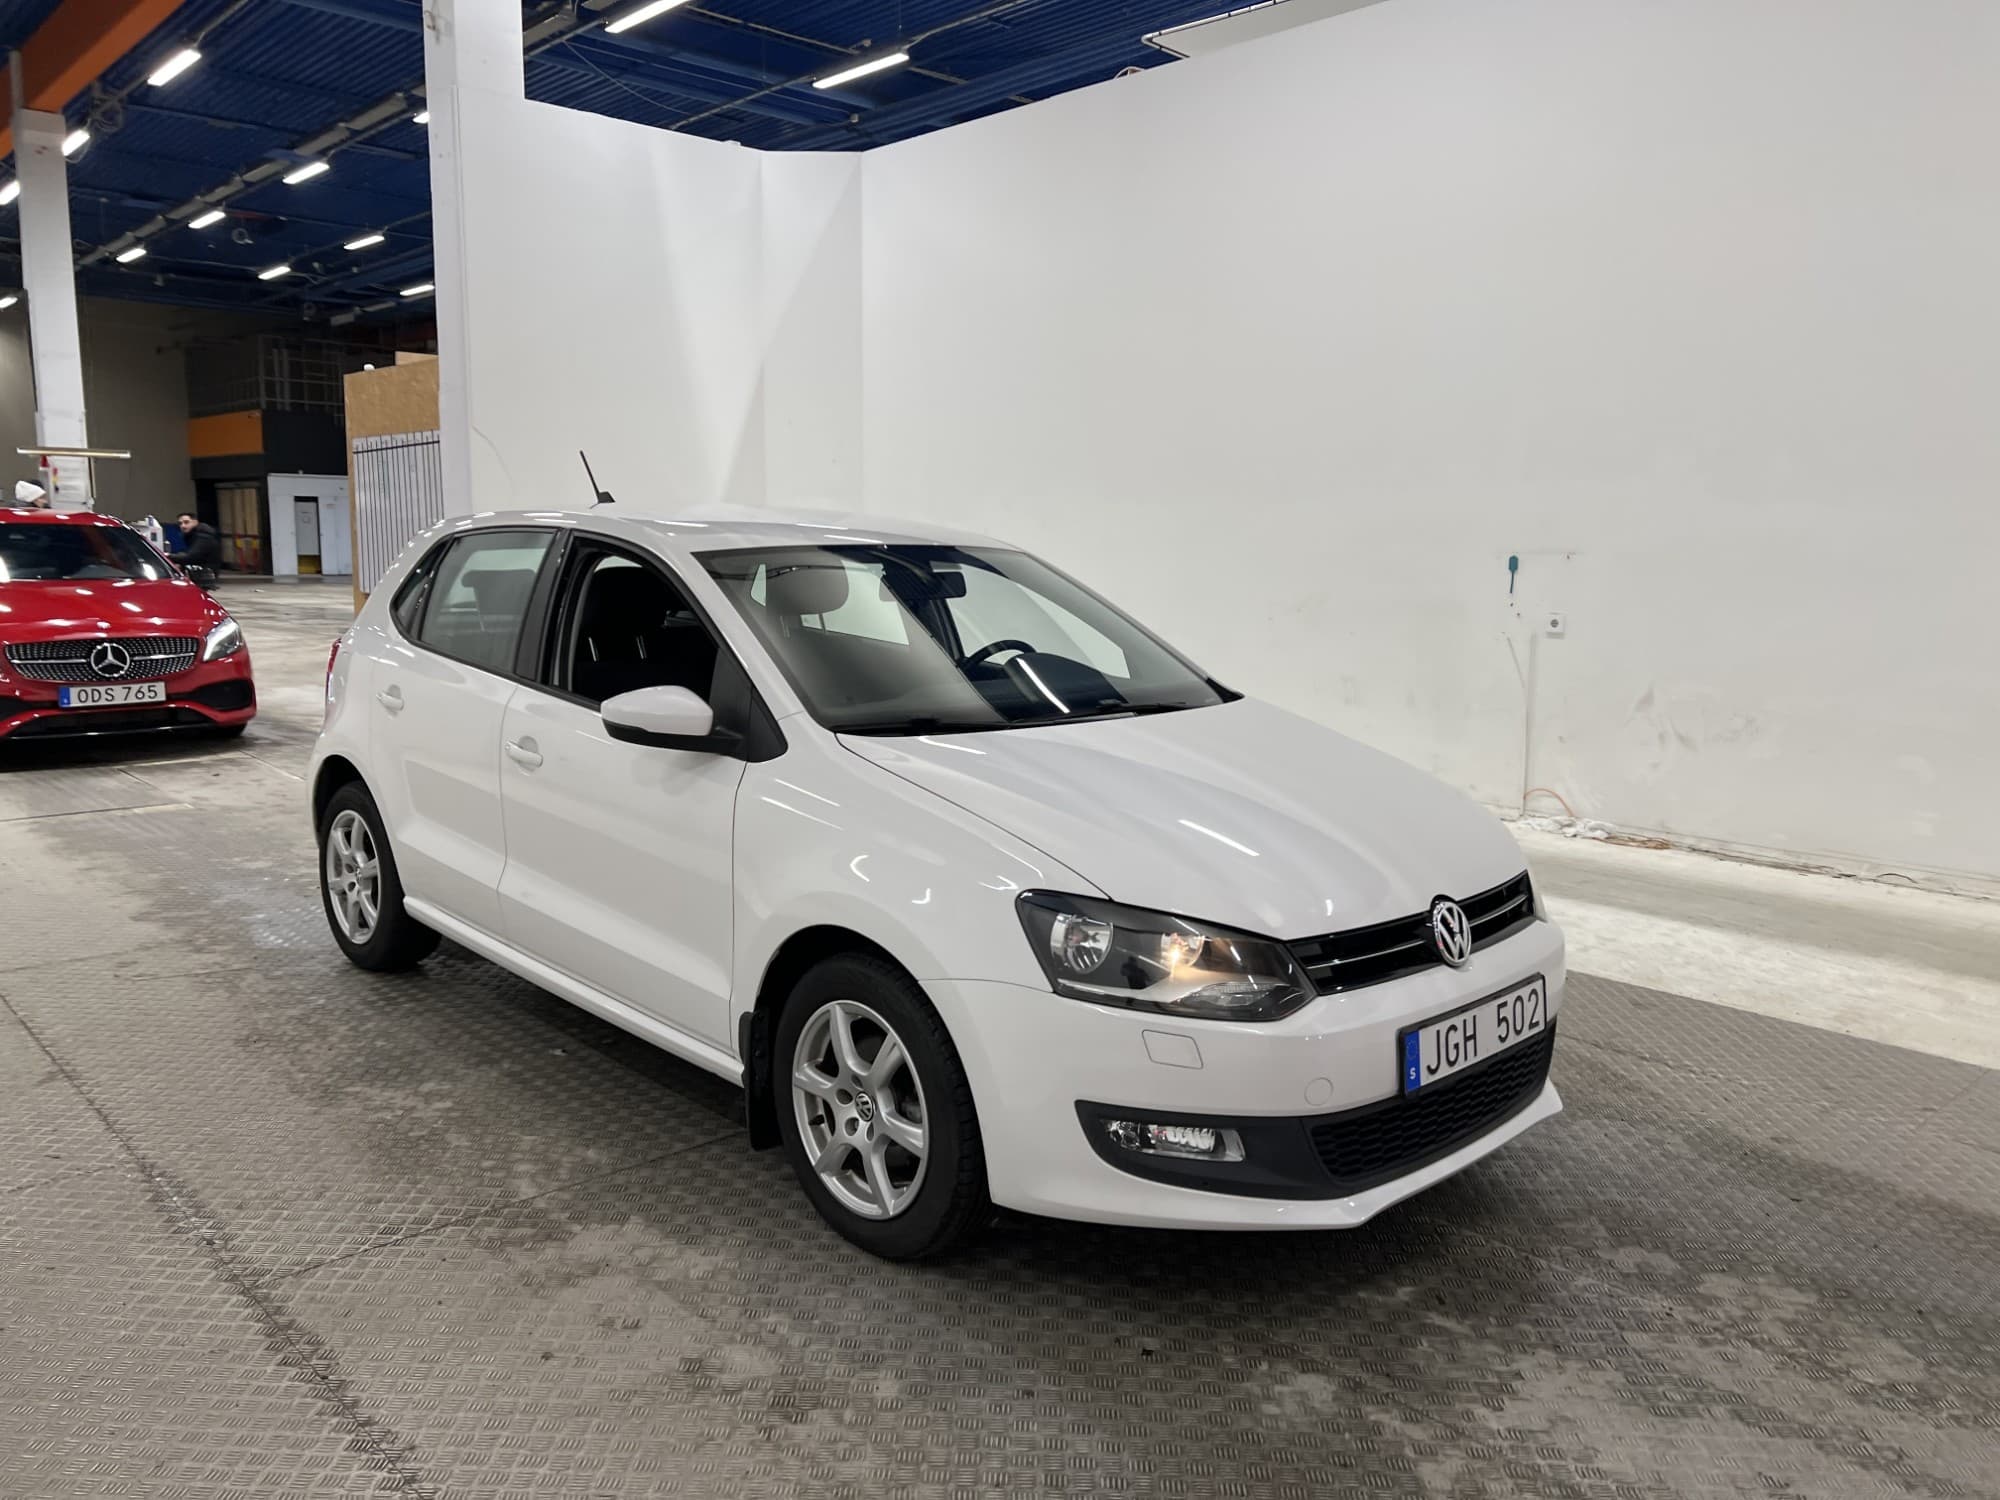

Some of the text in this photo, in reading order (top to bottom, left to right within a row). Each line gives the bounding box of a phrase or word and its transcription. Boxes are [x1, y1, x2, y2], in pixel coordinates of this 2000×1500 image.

[78, 688, 115, 703] ODS
[122, 686, 158, 700] 765
[1426, 988, 1540, 1076] JGH 502
[1409, 1066, 1417, 1081] S
